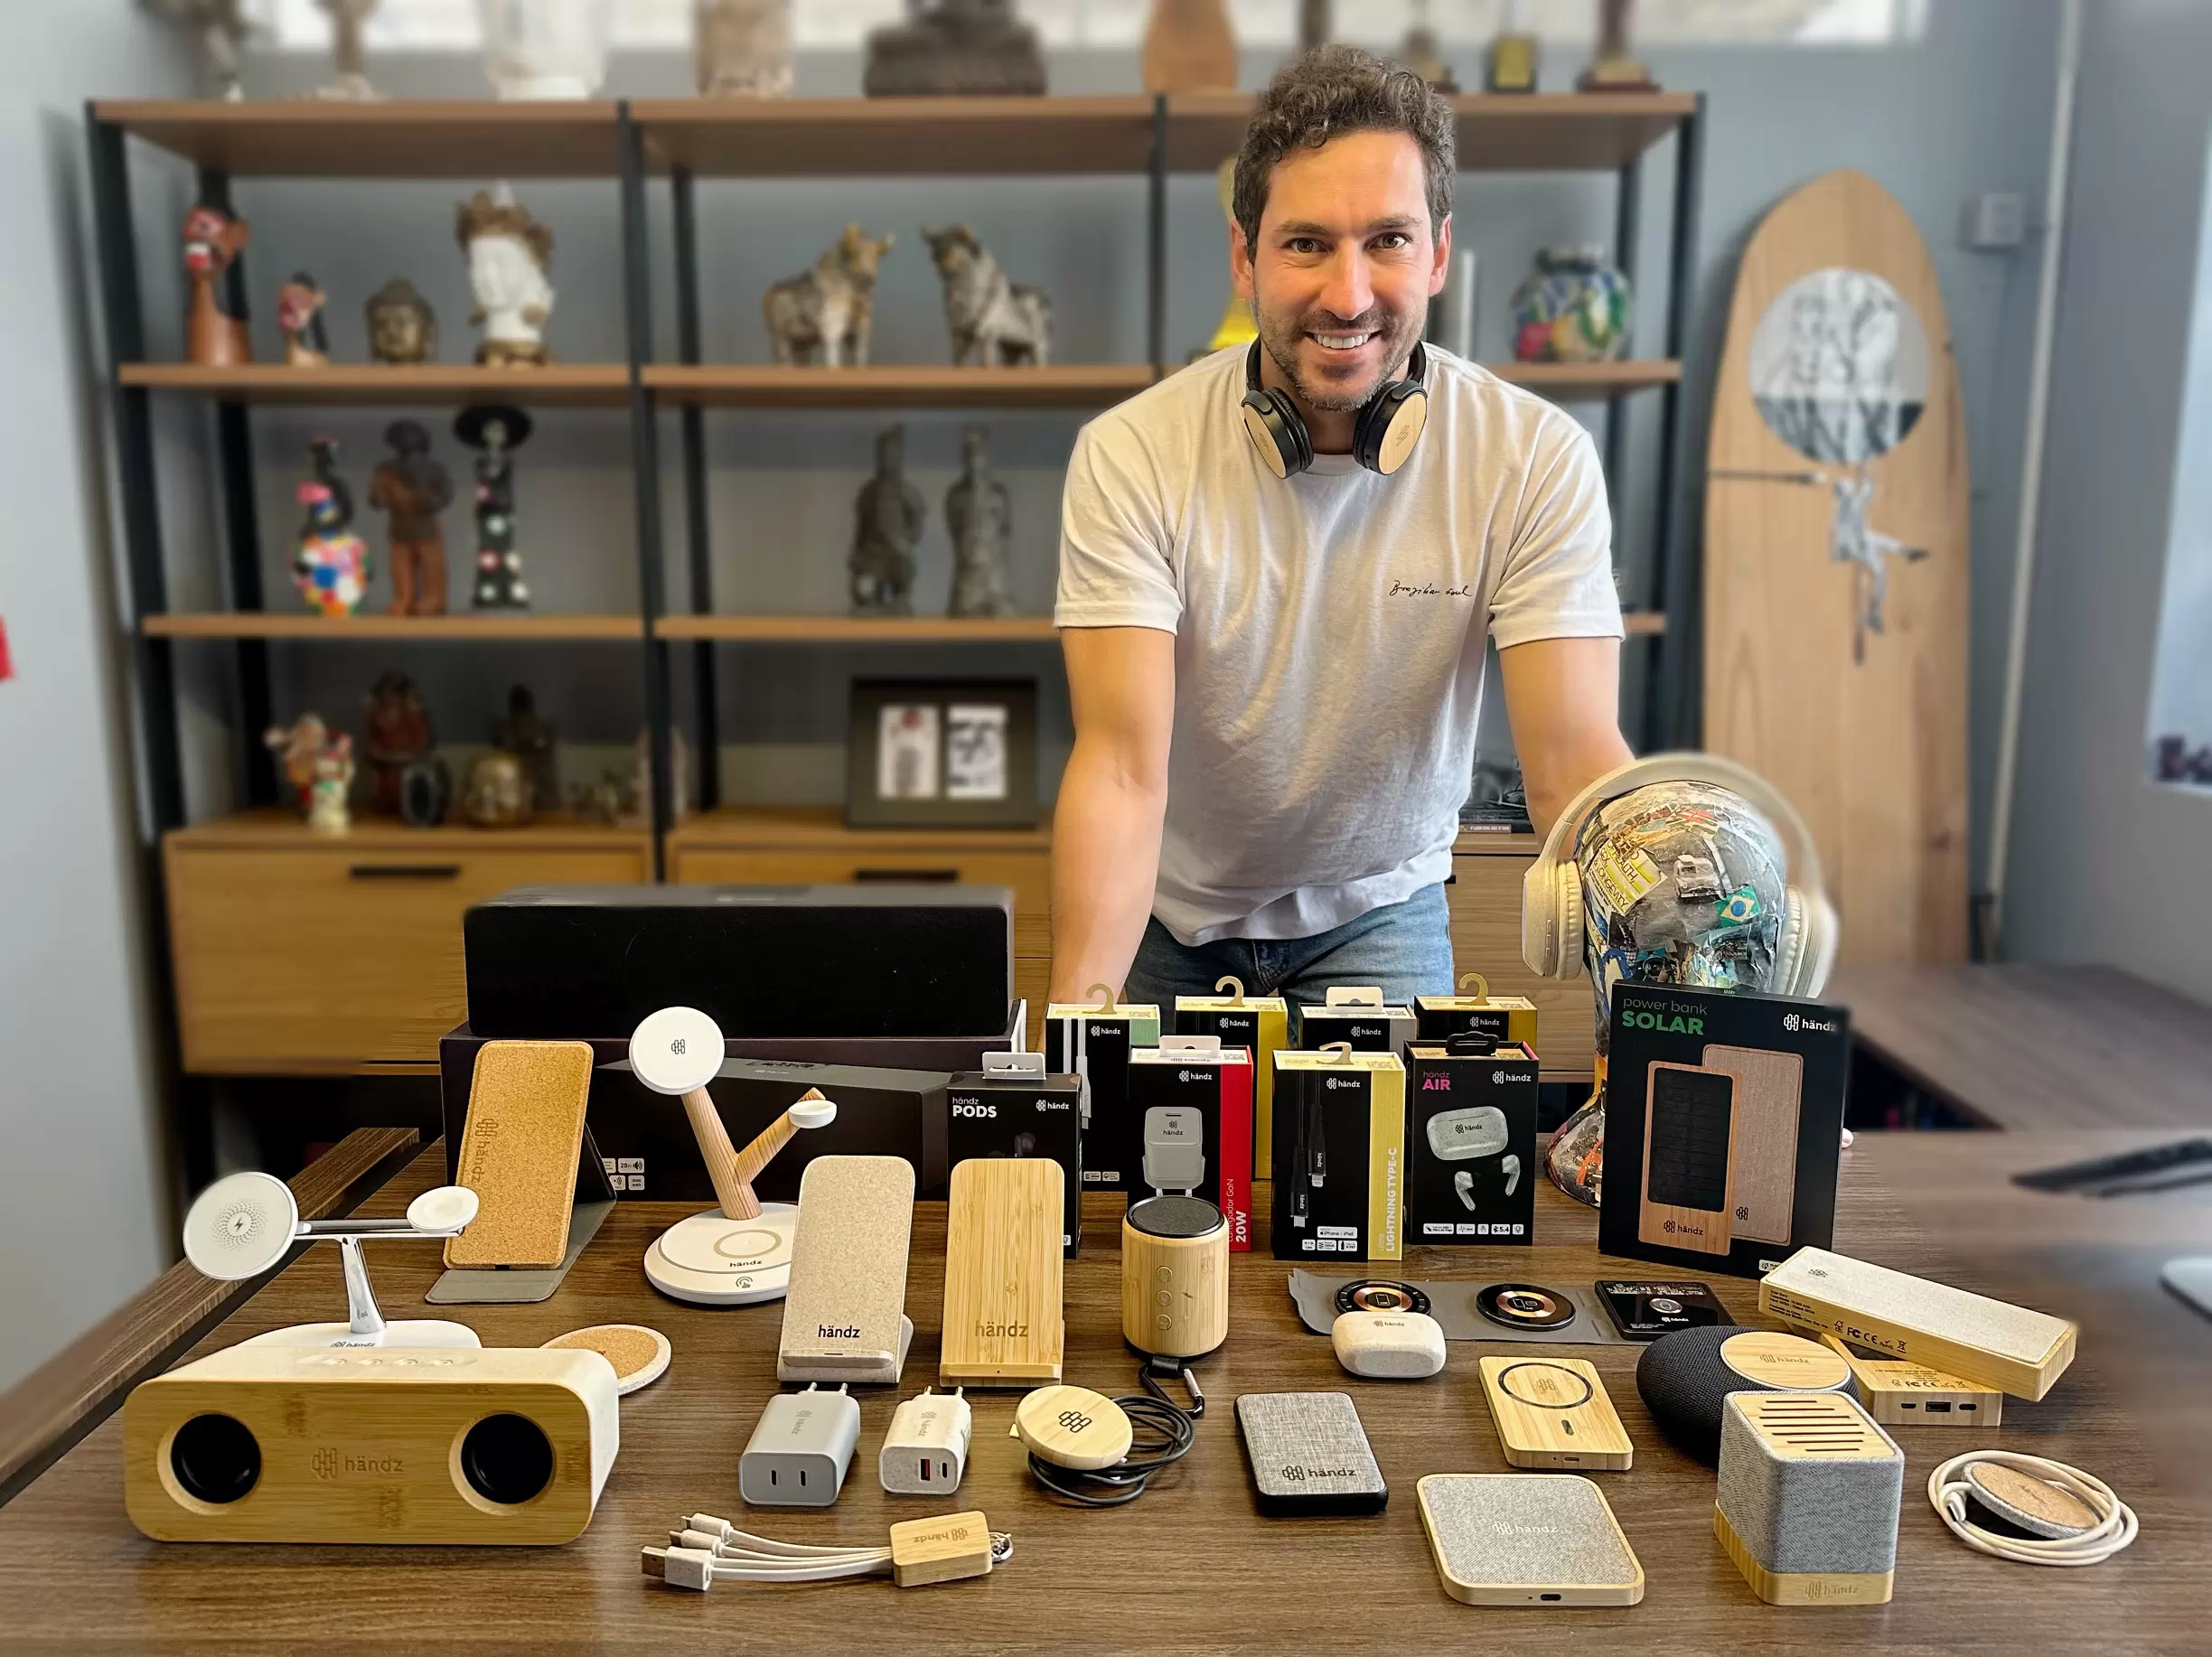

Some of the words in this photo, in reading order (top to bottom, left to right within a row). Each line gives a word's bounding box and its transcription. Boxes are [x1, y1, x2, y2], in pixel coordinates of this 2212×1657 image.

[1599, 847, 1610, 868] SEX,
[1612, 852, 1639, 885] HEALTH,
[1596, 866, 1629, 908] LONGEVITY
[1623, 997, 1667, 1013] power
[1671, 999, 1708, 1016] bank
[1101, 1027, 1120, 1035] händz
[1229, 1019, 1249, 1027] händz
[1622, 1011, 1705, 1036] SOLAR
[1802, 1017, 1837, 1033] händz
[1190, 1072, 1213, 1081] händz
[1337, 1080, 1361, 1088] händz
[1505, 1073, 1532, 1082] händz
[1422, 1079, 1451, 1091] AIR
[952, 1097, 979, 1105] händz
[952, 1106, 998, 1119] PODS
[1387, 1147, 1397, 1187] TYPE-C
[1226, 1178, 1234, 1196] GaN
[1235, 1211, 1247, 1243] 20W
[1386, 1190, 1396, 1252] LIGHTNING
[1677, 1224, 1704, 1236] händz
[818, 1325, 860, 1339] händz
[975, 1321, 1029, 1337] händz
[344, 1455, 403, 1473] händz
[1308, 1468, 1357, 1476] händz
